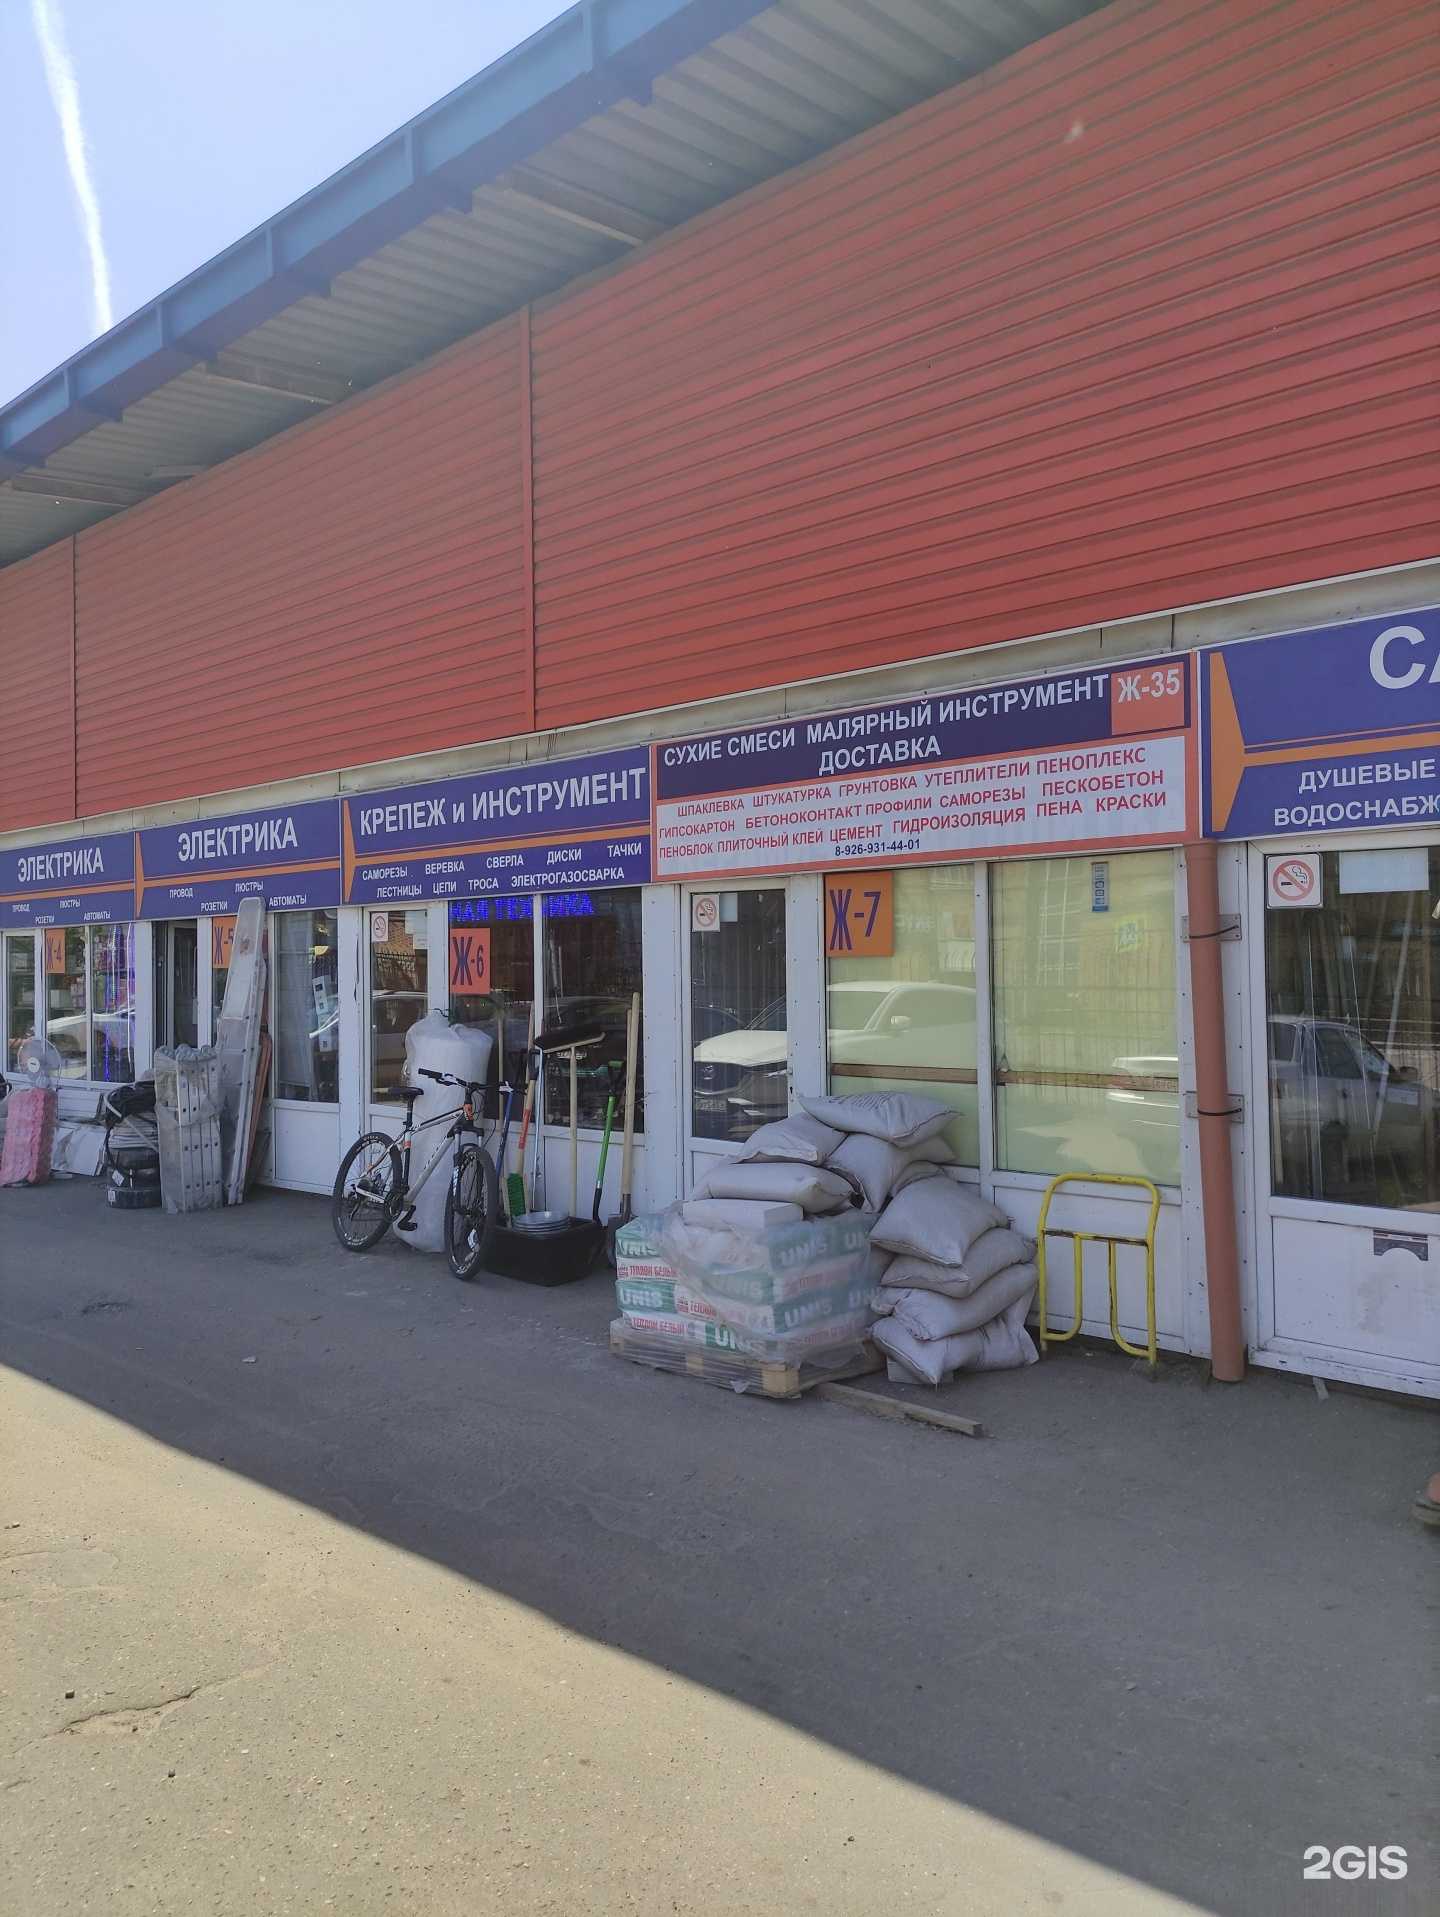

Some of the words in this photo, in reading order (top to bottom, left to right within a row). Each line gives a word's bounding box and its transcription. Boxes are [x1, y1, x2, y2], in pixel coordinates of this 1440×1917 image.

[1117, 669, 1181, 703] Ж-35
[664, 740, 721, 767] СУХИЕ
[727, 728, 795, 756] СМЕСИ
[807, 699, 931, 745] МАЛЯРНЫЙ
[939, 674, 1109, 723] ИНСТРУМЕНТ
[818, 735, 941, 776] ДОСТАВКА
[1299, 758, 1436, 794] ДУШЕВЫЕ
[360, 797, 447, 836] КРЕПЕЖ
[452, 801, 465, 824] и
[472, 767, 646, 821] ИНСТРУМЕНТ
[677, 798, 745, 818] ШПАКЛЕВКА
[753, 787, 832, 808] ШТУКАТУРКА
[839, 774, 917, 797] ГРУНТОВКА
[924, 762, 1030, 789] УТЕПЛИТЕЛИ
[1036, 747, 1146, 775] ПЕНОПЛЕКС
[659, 820, 735, 839] ГИПСОКАРТОН
[745, 805, 862, 829] БЕТОНОКОНТАКТ
[865, 797, 932, 816] ПРОФИЛИ
[939, 786, 1026, 809] САМОРЕЗЫ
[1042, 769, 1164, 797] ПЕСКОБЕТОН
[178, 817, 298, 862] ЭЛЕКТРИКА
[659, 841, 713, 859] ПЕНОБЛОК
[717, 832, 789, 852] ПЛИТОЧНЫЙ
[792, 827, 823, 845] КЛЕЙ
[830, 824, 883, 843] ЦЕМЕНТ
[892, 807, 1026, 835] ГИДРОИЗОЛЯЦИЯ
[1036, 801, 1082, 818] ПЕНА
[1096, 791, 1166, 813] КРАСКИ
[18, 847, 104, 882] ЭЛЕКТРИКА
[362, 866, 408, 881] САМОРЕЗЫ
[425, 861, 465, 875] ВЕРЕВКА
[486, 854, 524, 869] СВЕРЛА
[546, 848, 582, 865] ДИСКИ
[607, 842, 642, 858] ТАЧКИ
[835, 839, 920, 857] 8-926-931-44-01
[169, 887, 193, 899] ПРОВОД
[234, 881, 264, 894] ЛЮСТРЫ
[376, 884, 423, 898] ЛЕСТНИЦЫ
[433, 880, 457, 895] ЦЕПИ
[468, 876, 499, 891] ТРОСА
[511, 867, 625, 888] ЭЛЕКТРОГАЗОСВАРКА
[200, 901, 228, 913] РОЗЕТКИ
[268, 894, 307, 907] АВТОМАТЫ
[829, 889, 882, 950] Ж-7
[452, 936, 485, 986] Ж-6
